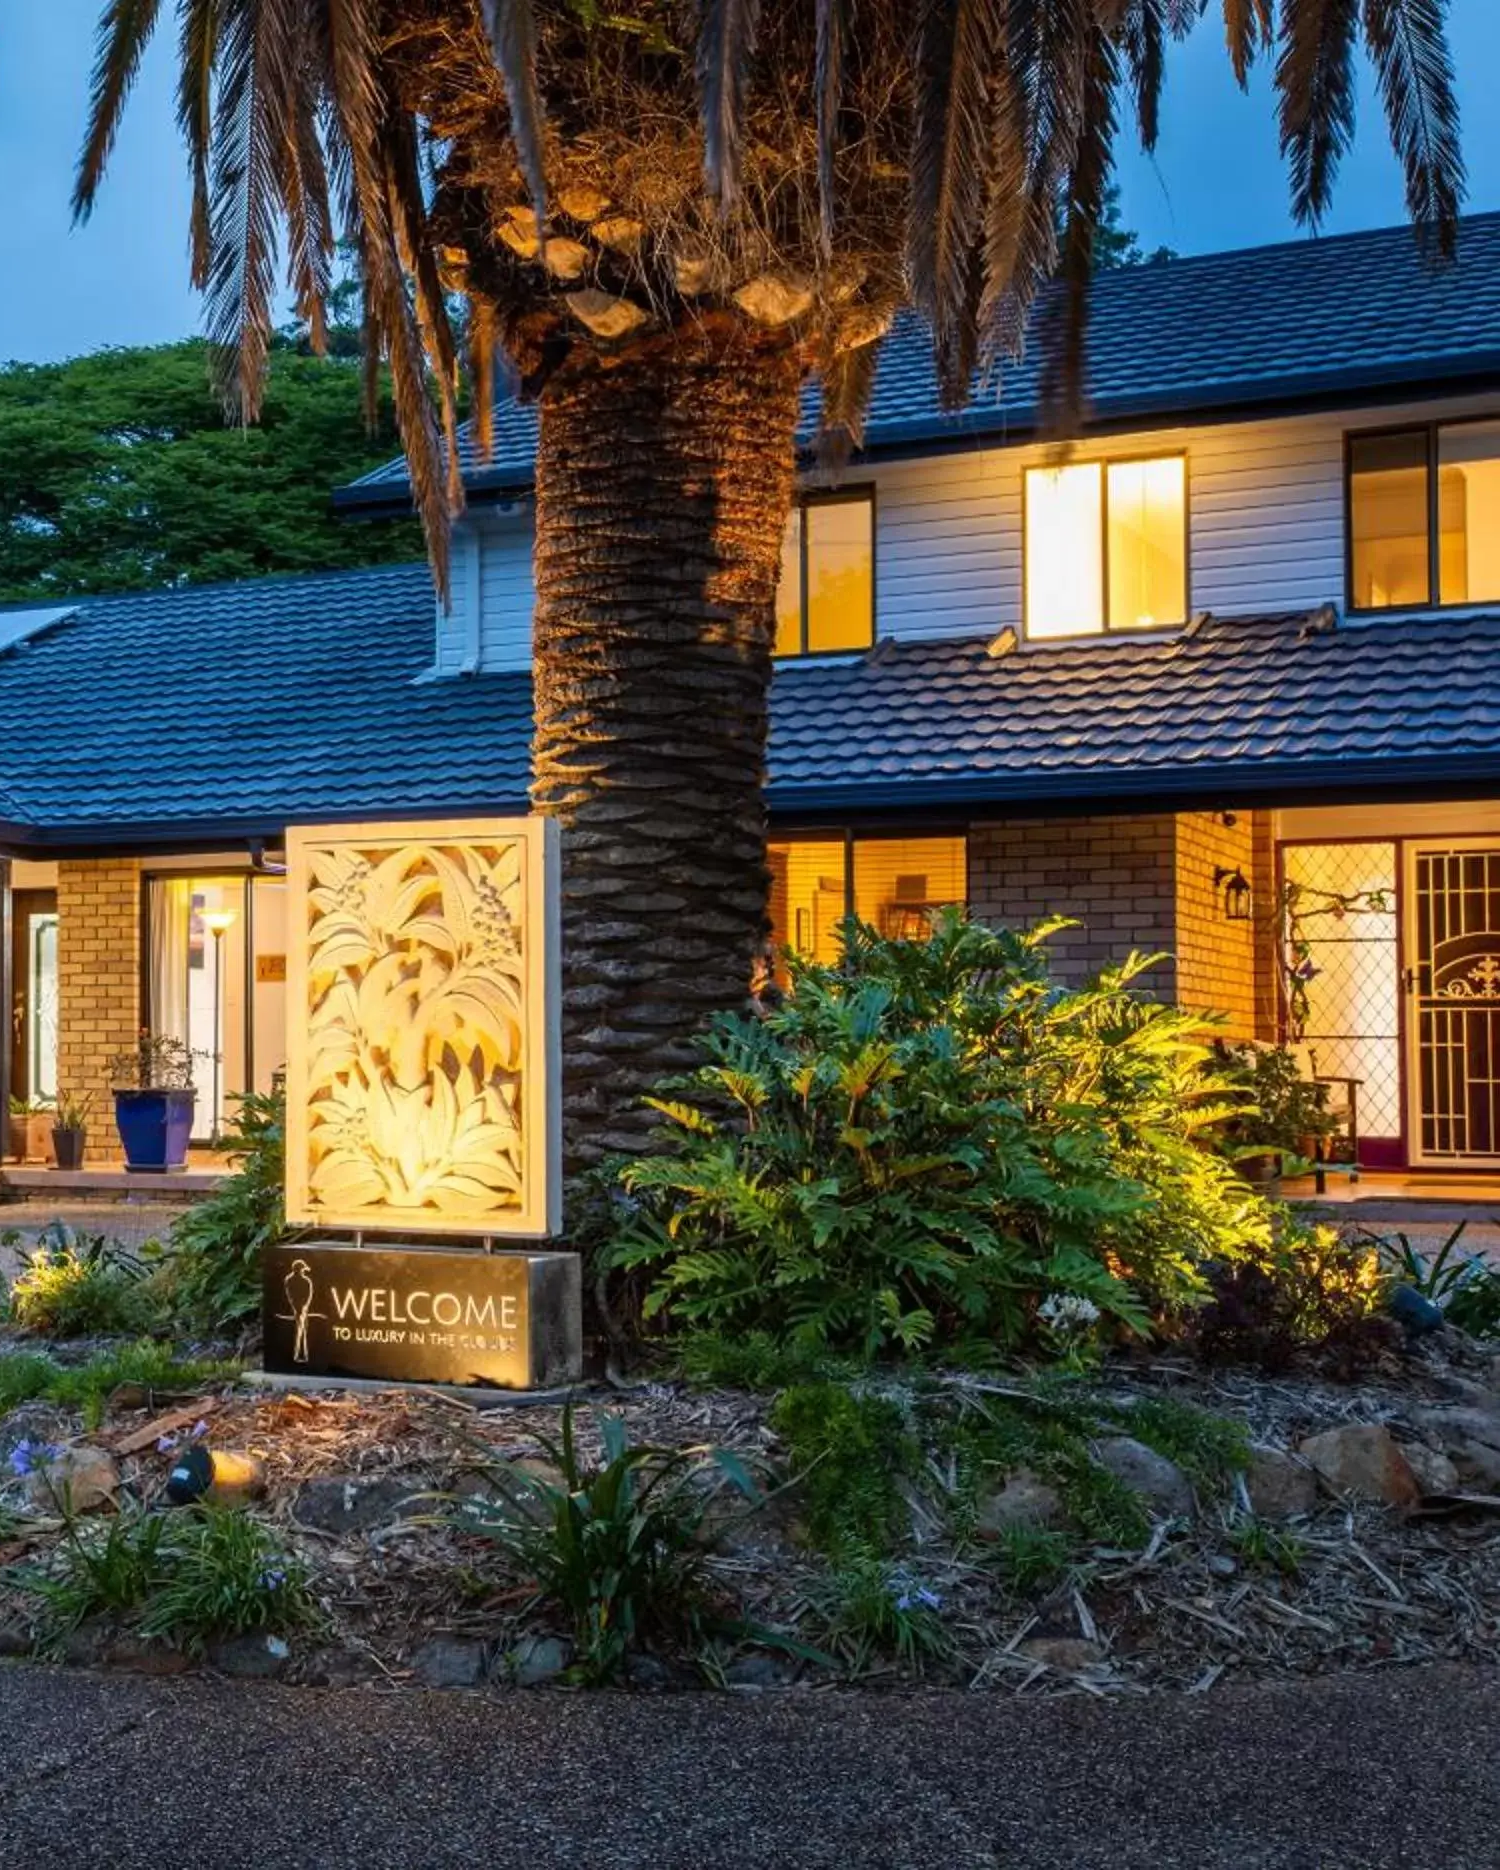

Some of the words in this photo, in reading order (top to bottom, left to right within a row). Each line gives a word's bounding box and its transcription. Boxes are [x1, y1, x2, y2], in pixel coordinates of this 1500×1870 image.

[331, 1287, 517, 1329] WELCOME
[332, 1327, 351, 1341] TO
[355, 1329, 405, 1343] LUXURY
[409, 1332, 425, 1345] IN
[429, 1333, 455, 1347] THE
